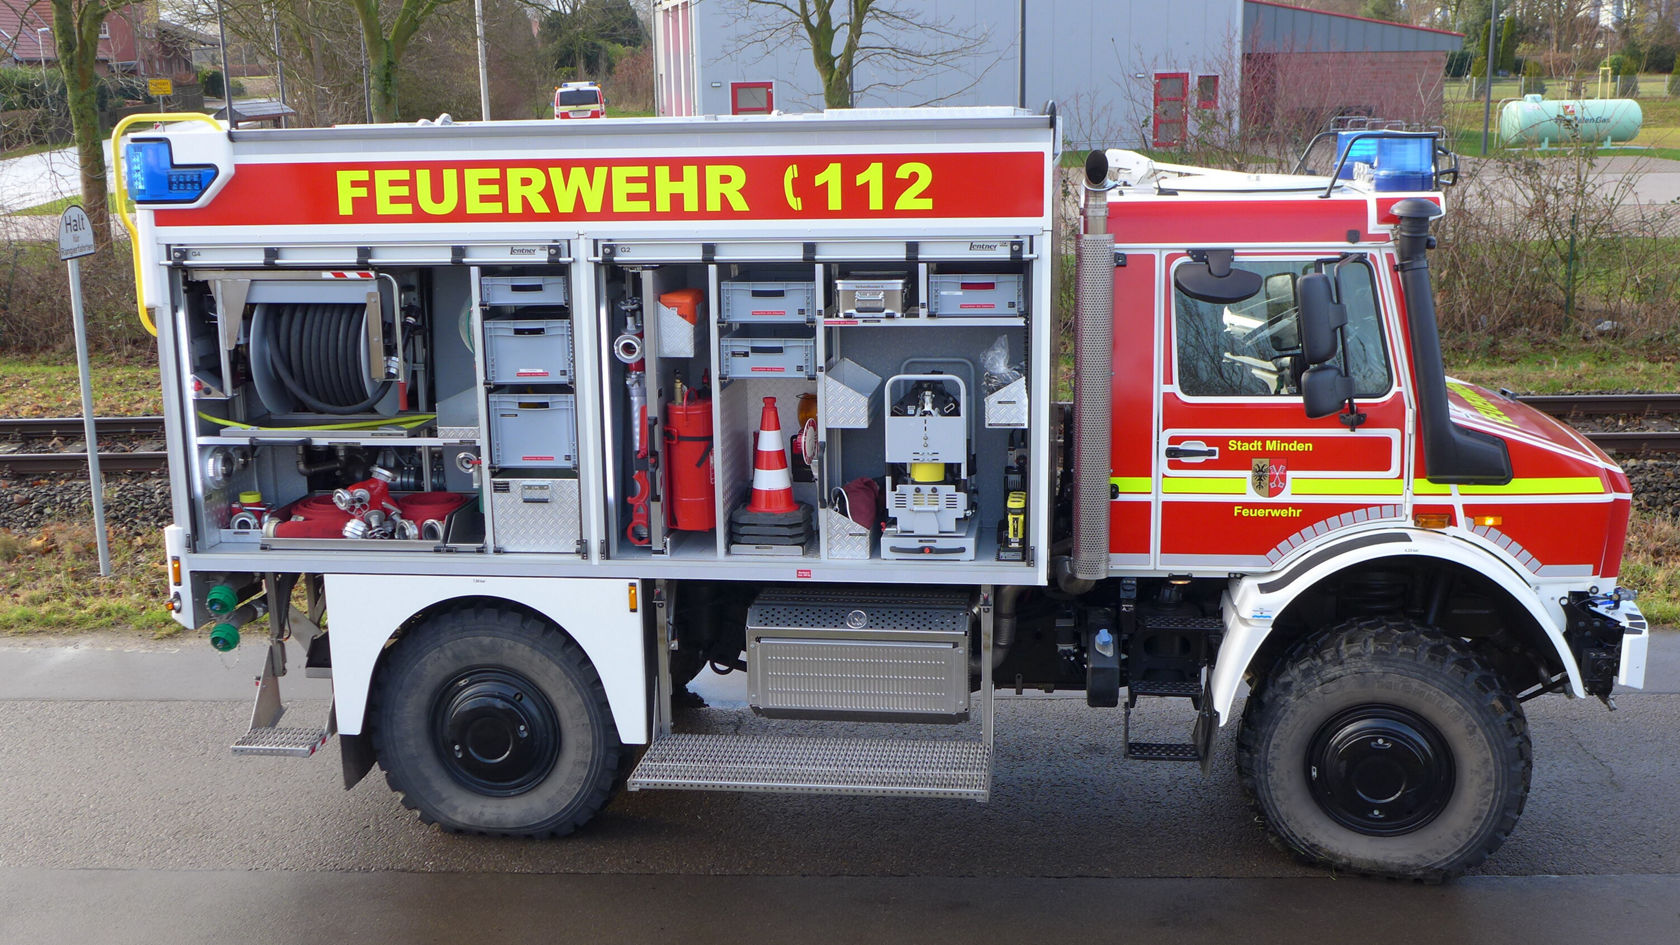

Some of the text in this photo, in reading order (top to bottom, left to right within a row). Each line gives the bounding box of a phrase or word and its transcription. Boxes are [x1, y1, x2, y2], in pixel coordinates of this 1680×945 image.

[336, 165, 750, 216] FEUERWEHR
[814, 162, 933, 211] 112
[65, 213, 85, 233] Halt
[1228, 439, 1313, 452] Stadt Minden
[1233, 505, 1303, 517] Feuerwehr
